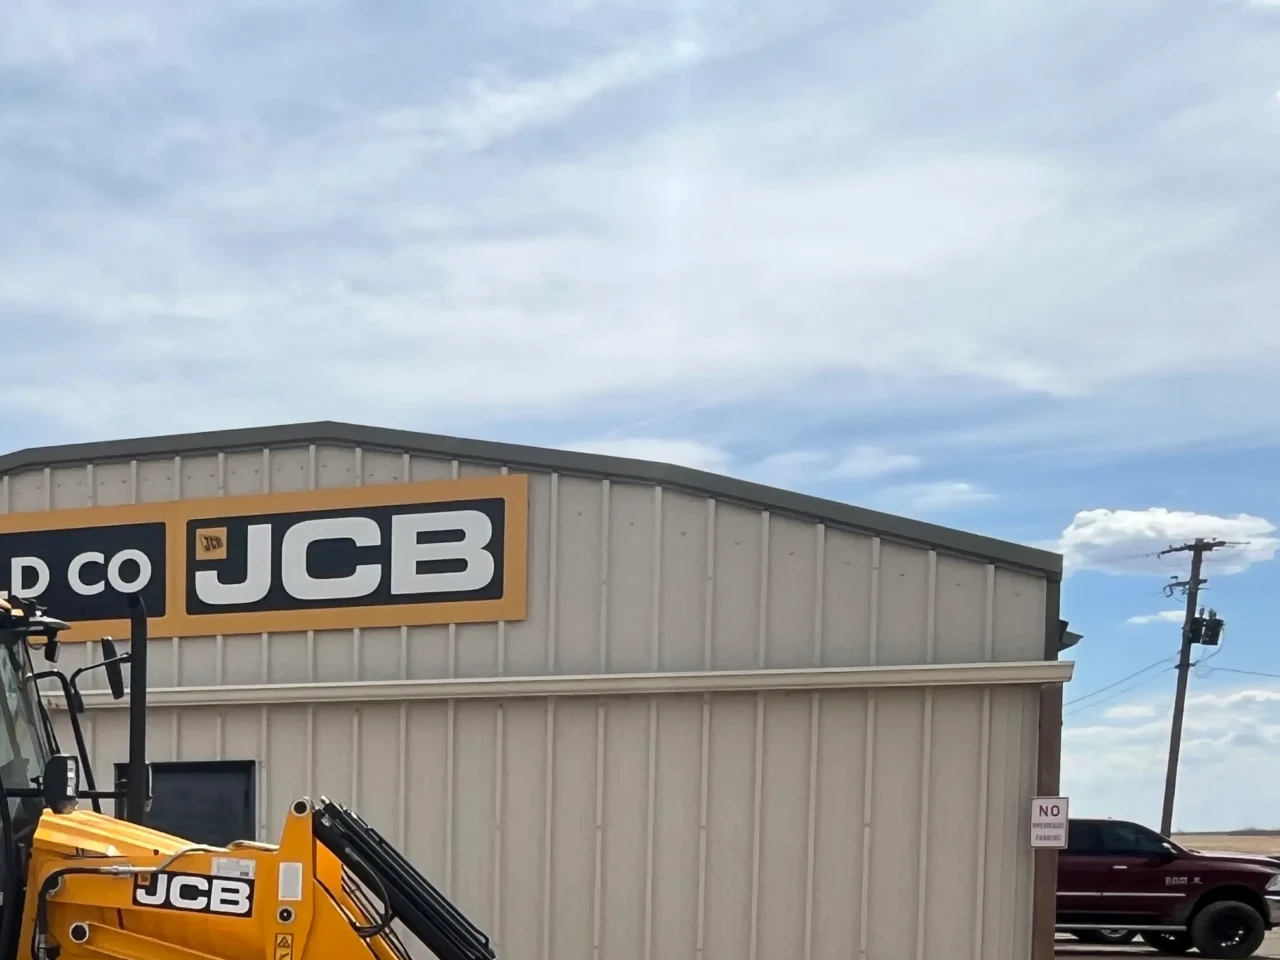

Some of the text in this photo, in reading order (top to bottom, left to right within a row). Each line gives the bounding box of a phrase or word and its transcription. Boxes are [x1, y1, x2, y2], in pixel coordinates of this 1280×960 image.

[67, 548, 152, 596] CO
[193, 509, 496, 606] JCB
[1039, 805, 1060, 817] NO
[135, 873, 251, 915] JCB
